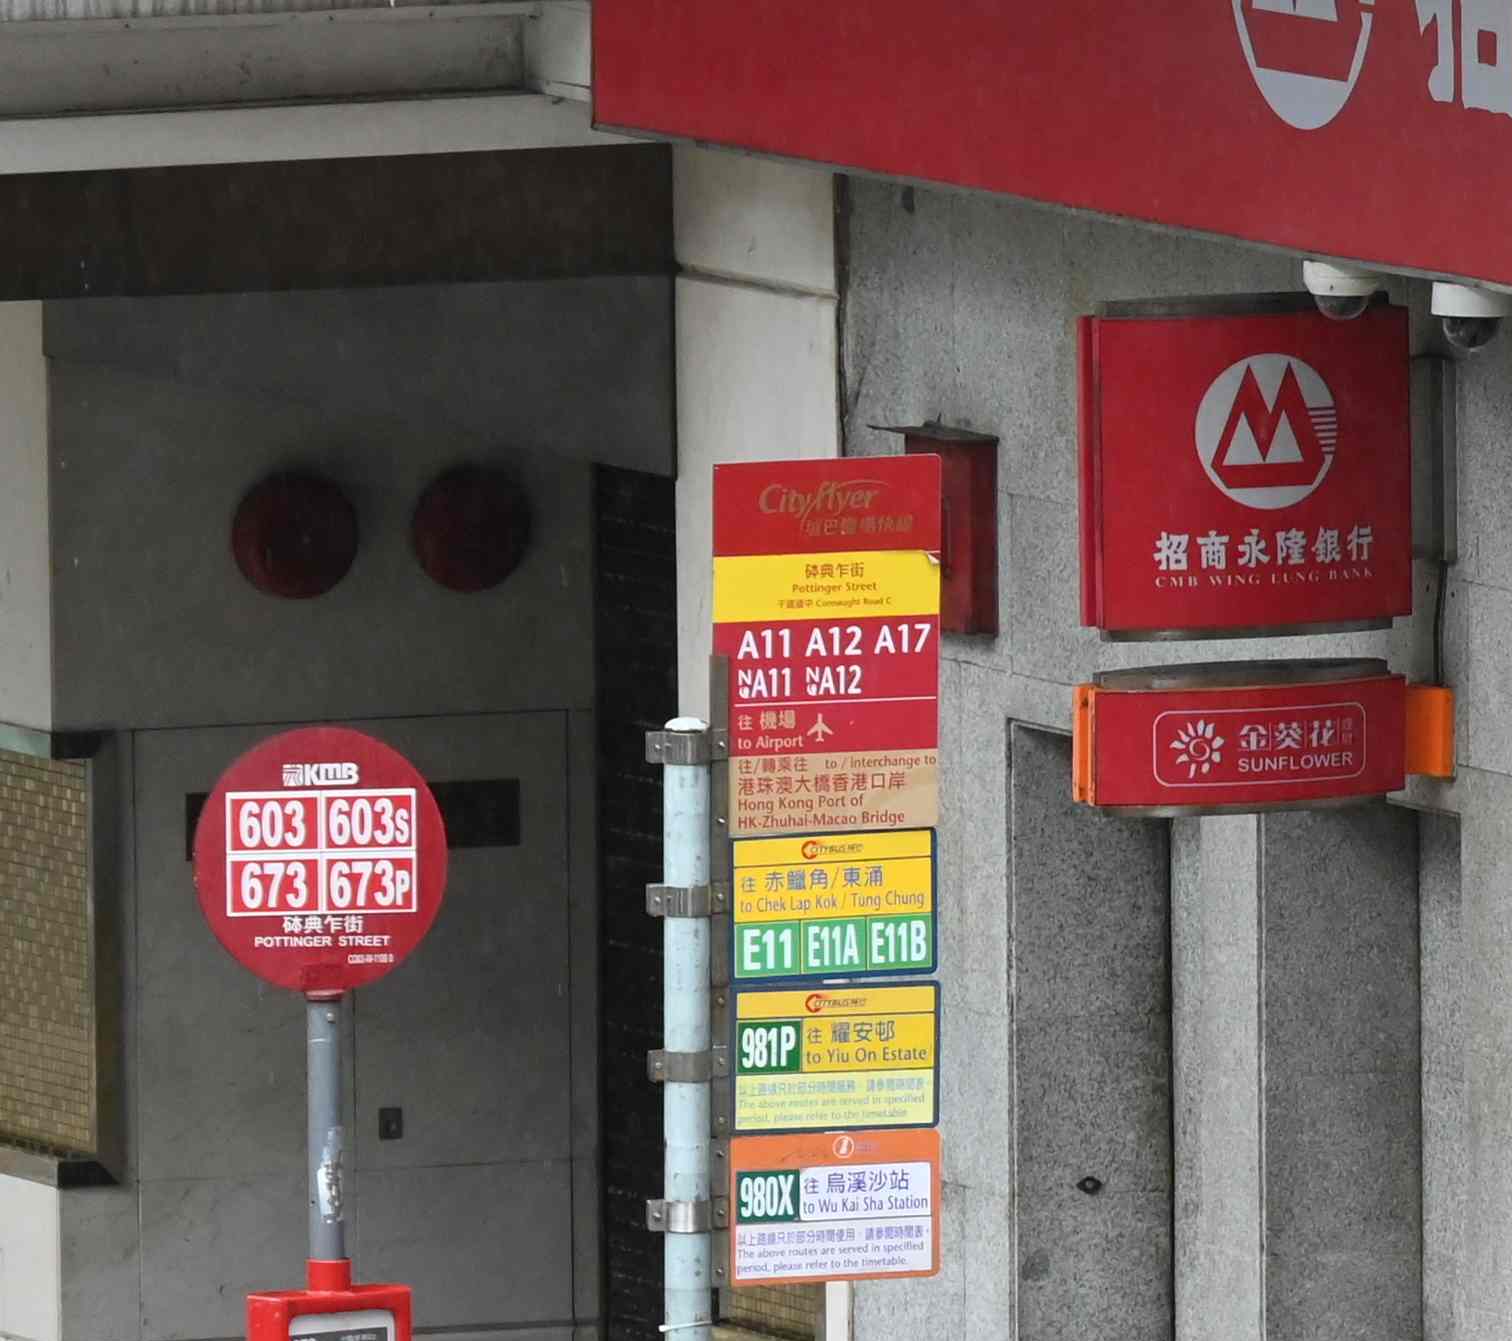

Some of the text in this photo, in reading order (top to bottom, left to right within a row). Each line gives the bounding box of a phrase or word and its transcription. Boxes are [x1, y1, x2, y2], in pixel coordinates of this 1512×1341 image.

[1152, 525, 1375, 571] 招商永隆銀行
[792, 581, 878, 595] Pottinger Street
[1155, 566, 1375, 589] CMB WING LUNG BANK
[737, 623, 932, 661] A11 A12 A17
[738, 664, 863, 699] NA11 NA12
[737, 709, 796, 732] 往 機場
[737, 732, 804, 753] to Airport
[1239, 718, 1336, 752] 金葵花
[825, 758, 837, 769] to
[924, 754, 937, 766] to
[1237, 751, 1354, 773] SUNFLOWER
[303, 763, 360, 786] KMB
[738, 772, 906, 796] 港珠澳大橋香港口岸
[738, 794, 864, 813] Hong Kong Port of
[238, 800, 306, 848] 603
[328, 797, 410, 846] 603S
[738, 810, 906, 830] HK-Zhuhai-Macao Bridge
[240, 861, 308, 909] 673
[329, 859, 410, 907] 673P
[741, 877, 757, 893] 往
[740, 890, 925, 915] to Chek Lap Kok Tung Chung
[282, 916, 364, 934] 砵典乍街
[254, 934, 391, 948] POTTINGER STREET
[743, 927, 794, 971] E11
[806, 923, 860, 967] E11A
[870, 919, 927, 963] E11B
[741, 1025, 796, 1069] 981P
[807, 1028, 823, 1045] 往
[806, 1046, 927, 1065] to Yiu On Estate
[740, 1174, 795, 1218] 980X
[804, 1178, 819, 1195] 往
[803, 1195, 929, 1215] to Wu Kai Sha Station
